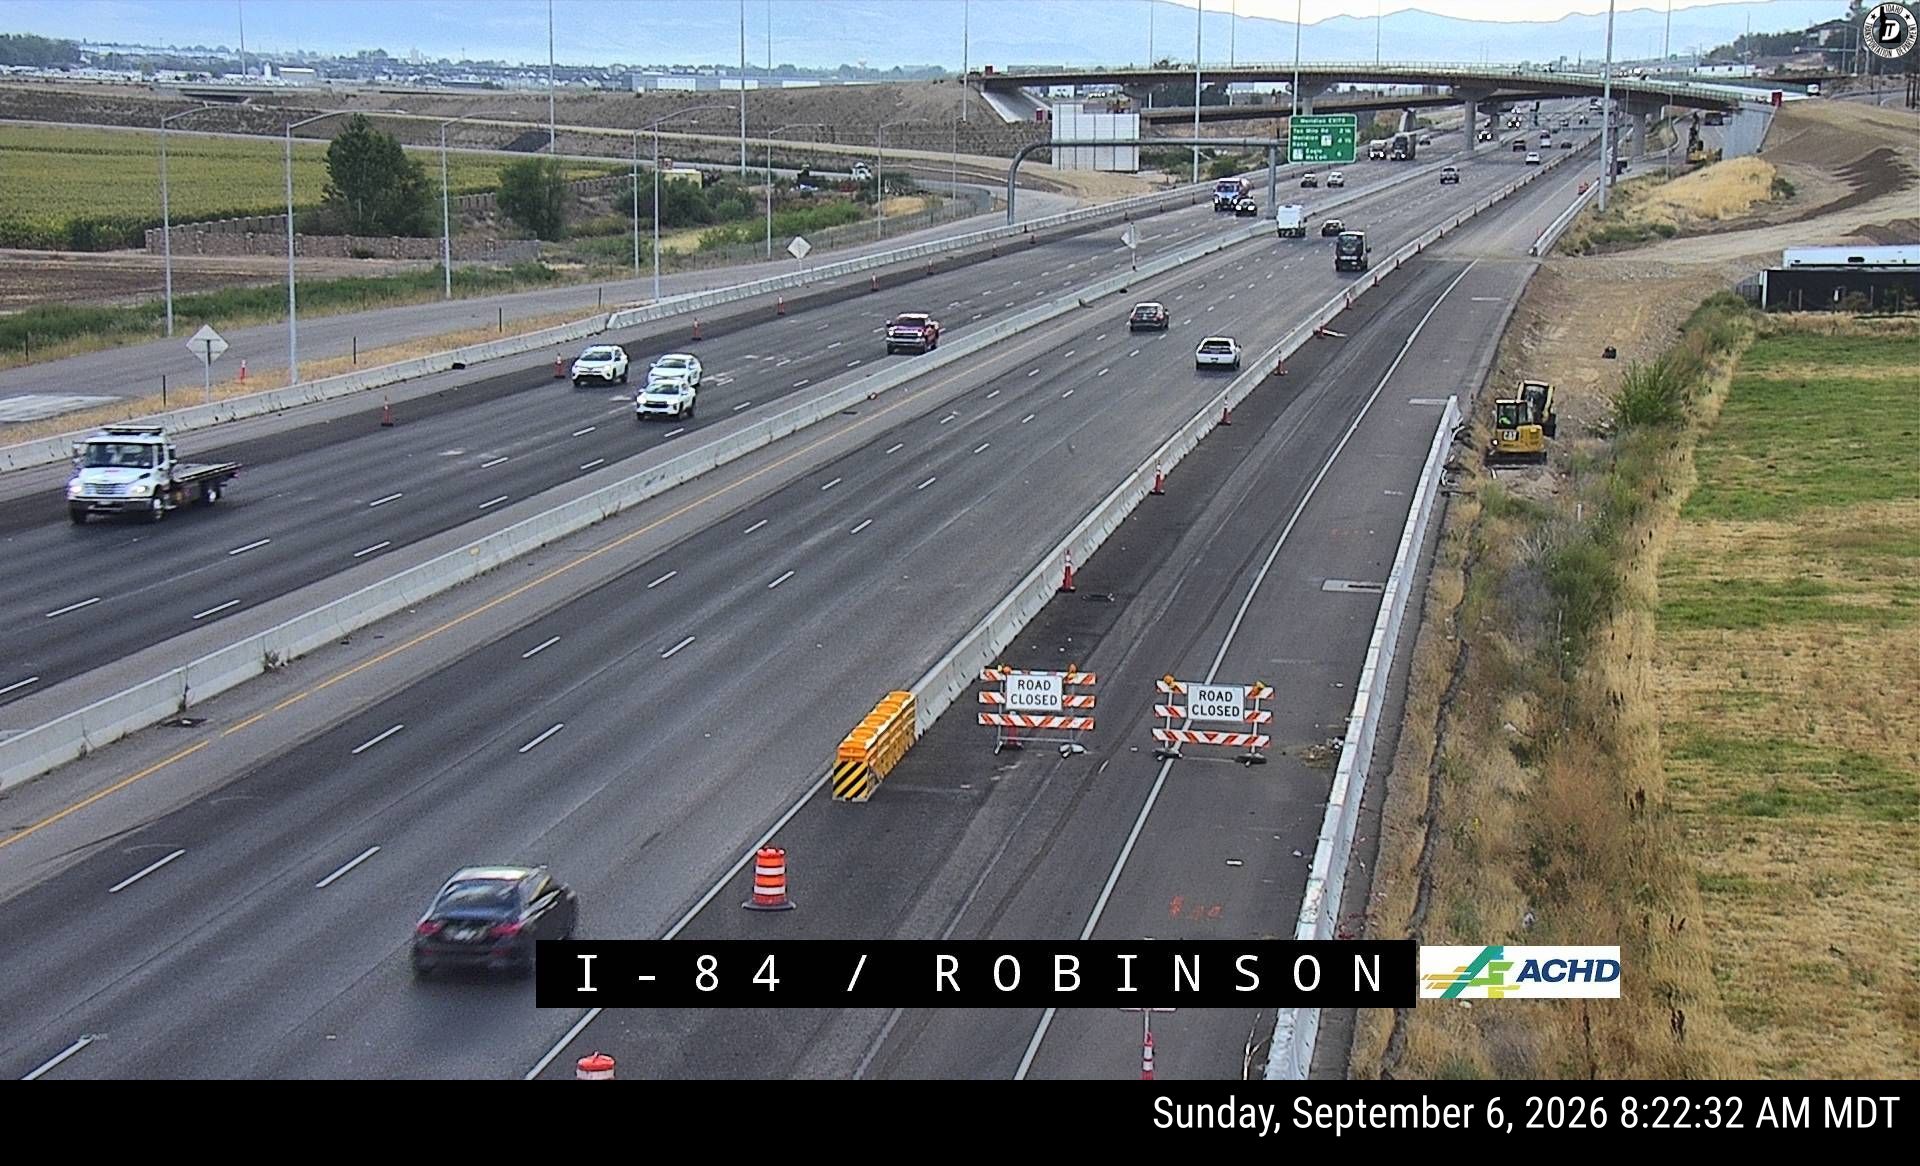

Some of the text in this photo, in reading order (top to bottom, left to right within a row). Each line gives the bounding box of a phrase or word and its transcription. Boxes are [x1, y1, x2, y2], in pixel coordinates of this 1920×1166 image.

[1017, 678, 1051, 692] ROAD
[1010, 693, 1058, 707] CLOSED
[1199, 689, 1233, 703] ROAD
[1191, 704, 1241, 718] CLOSED
